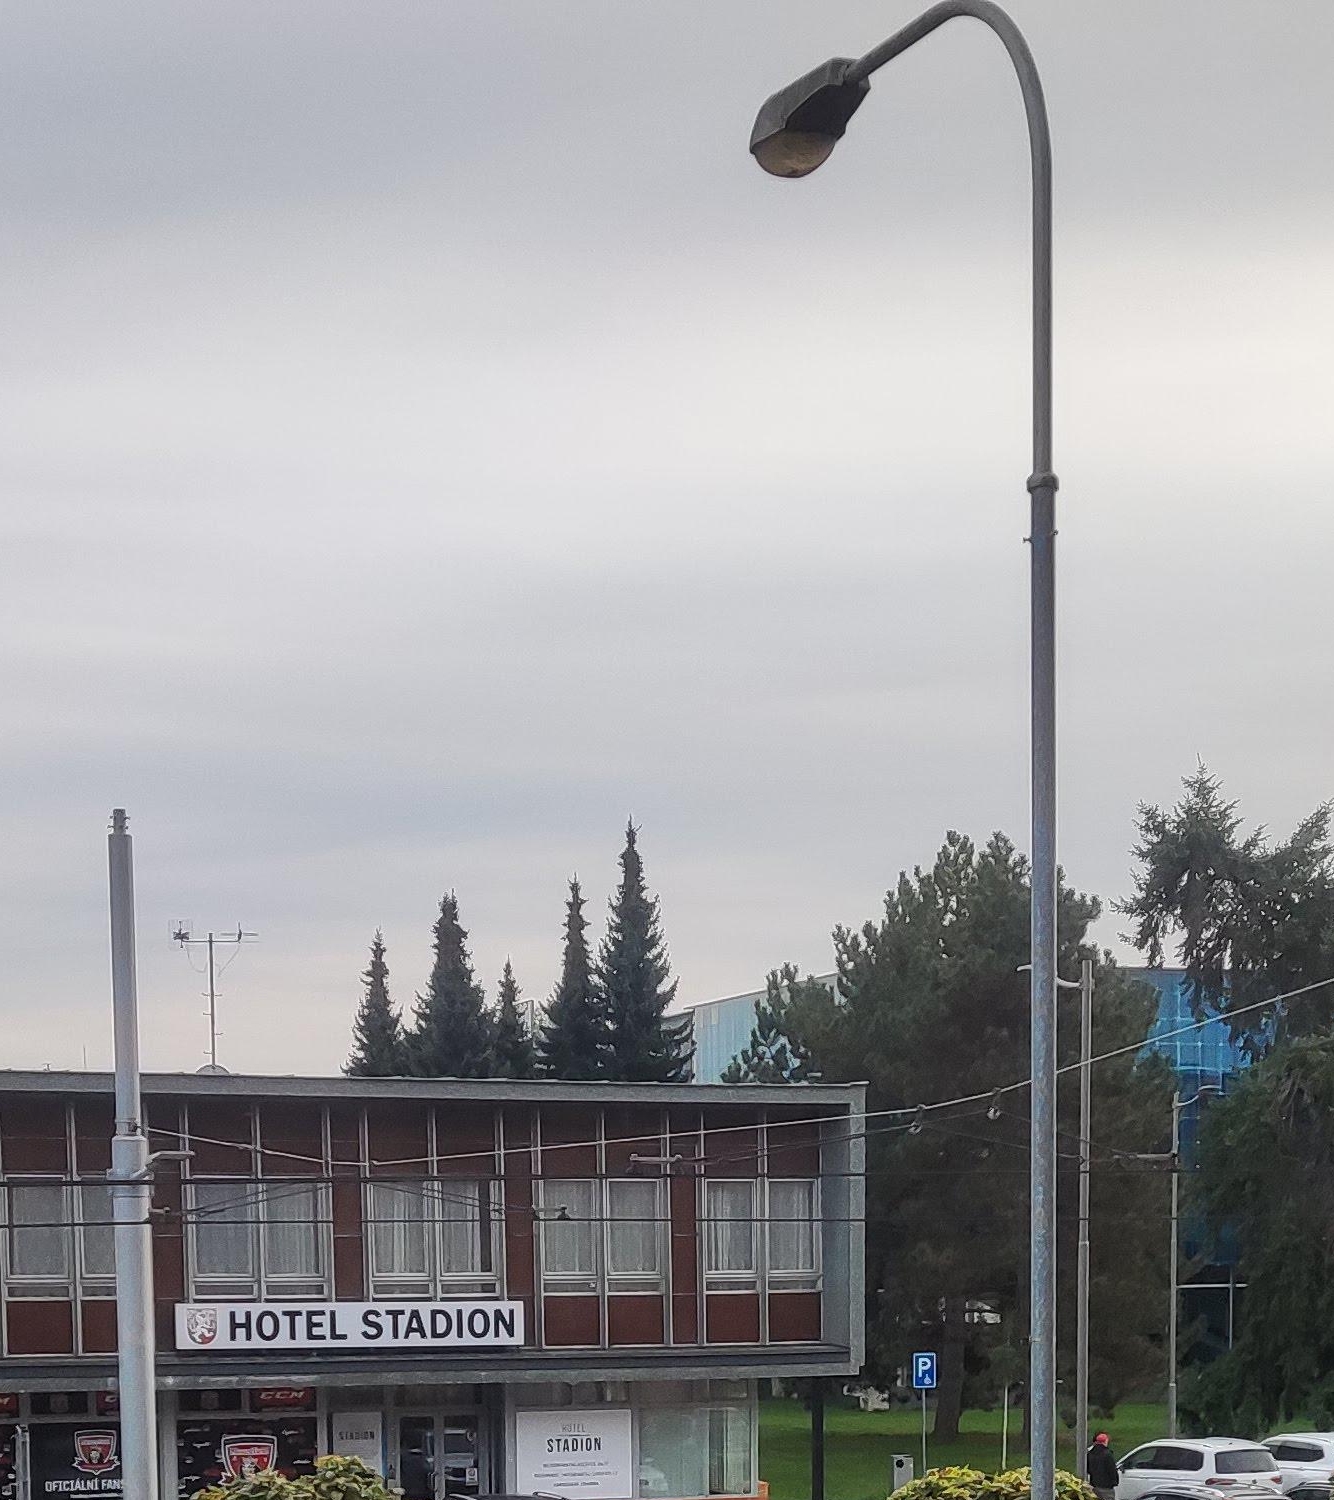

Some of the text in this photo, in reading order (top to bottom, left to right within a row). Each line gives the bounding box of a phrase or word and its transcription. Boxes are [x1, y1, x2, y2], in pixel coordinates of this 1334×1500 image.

[228, 1307, 516, 1342] HOTEL STADION
[918, 1357, 932, 1378] P
[258, 1390, 306, 1400] CCM
[338, 1430, 376, 1441] STADION
[561, 1423, 586, 1433] HOTEL
[546, 1436, 602, 1454] STADION
[44, 1477, 100, 1492] OFICIÁLNÍ
